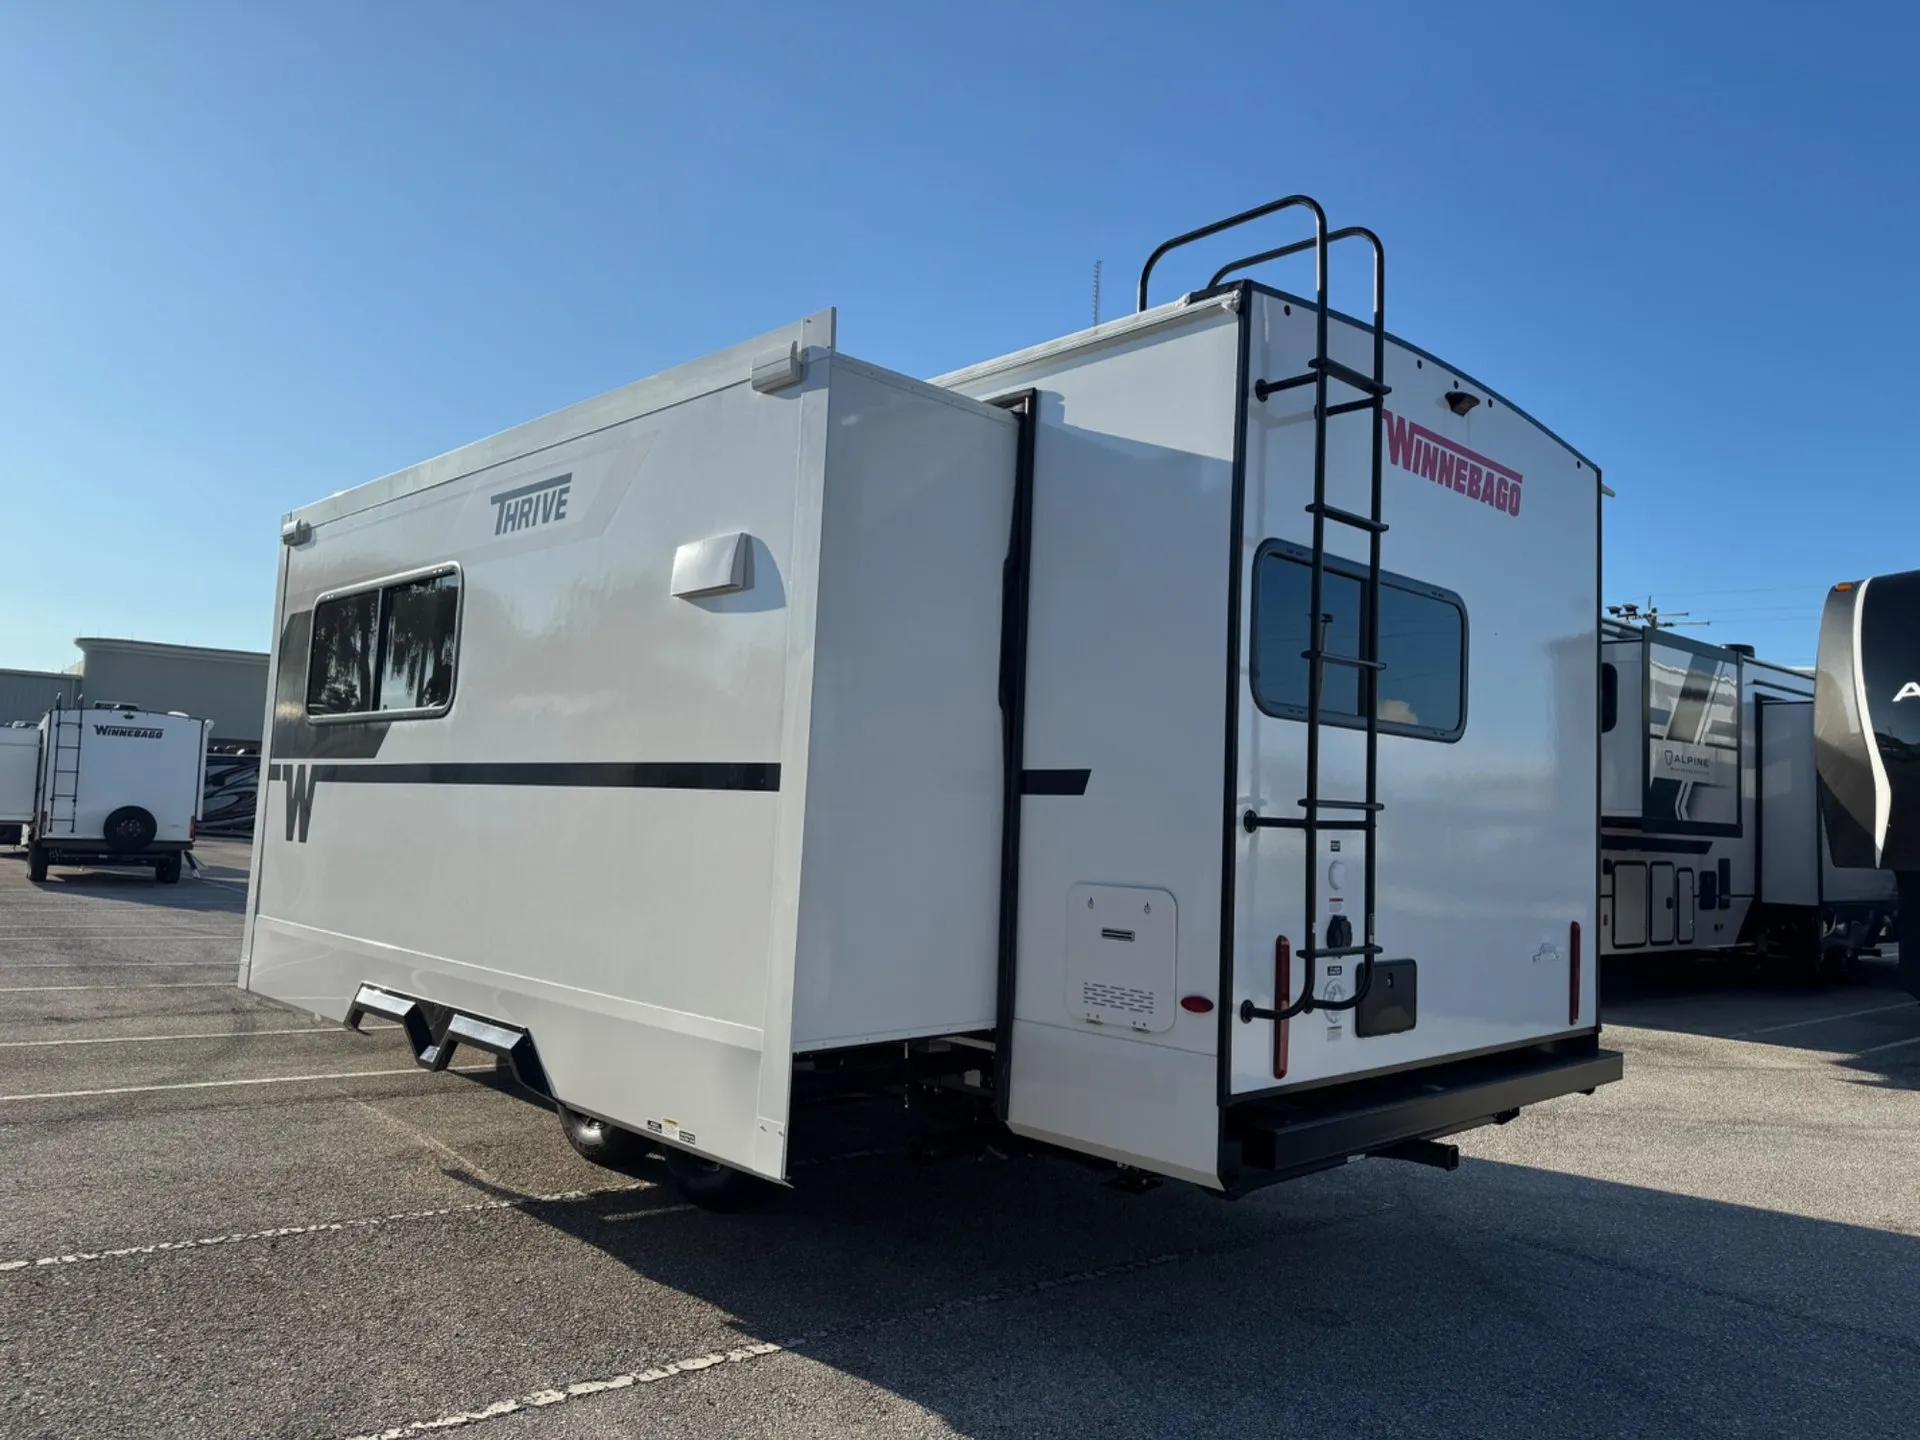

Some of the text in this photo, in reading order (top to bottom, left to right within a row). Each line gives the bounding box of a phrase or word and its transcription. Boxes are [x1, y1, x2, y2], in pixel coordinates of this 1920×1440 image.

[1382, 408, 1523, 517] WINNEBAGO
[490, 472, 572, 536] THRIVE
[93, 724, 164, 739] WINNEBAGO
[1674, 754, 1710, 767] ALPINE
